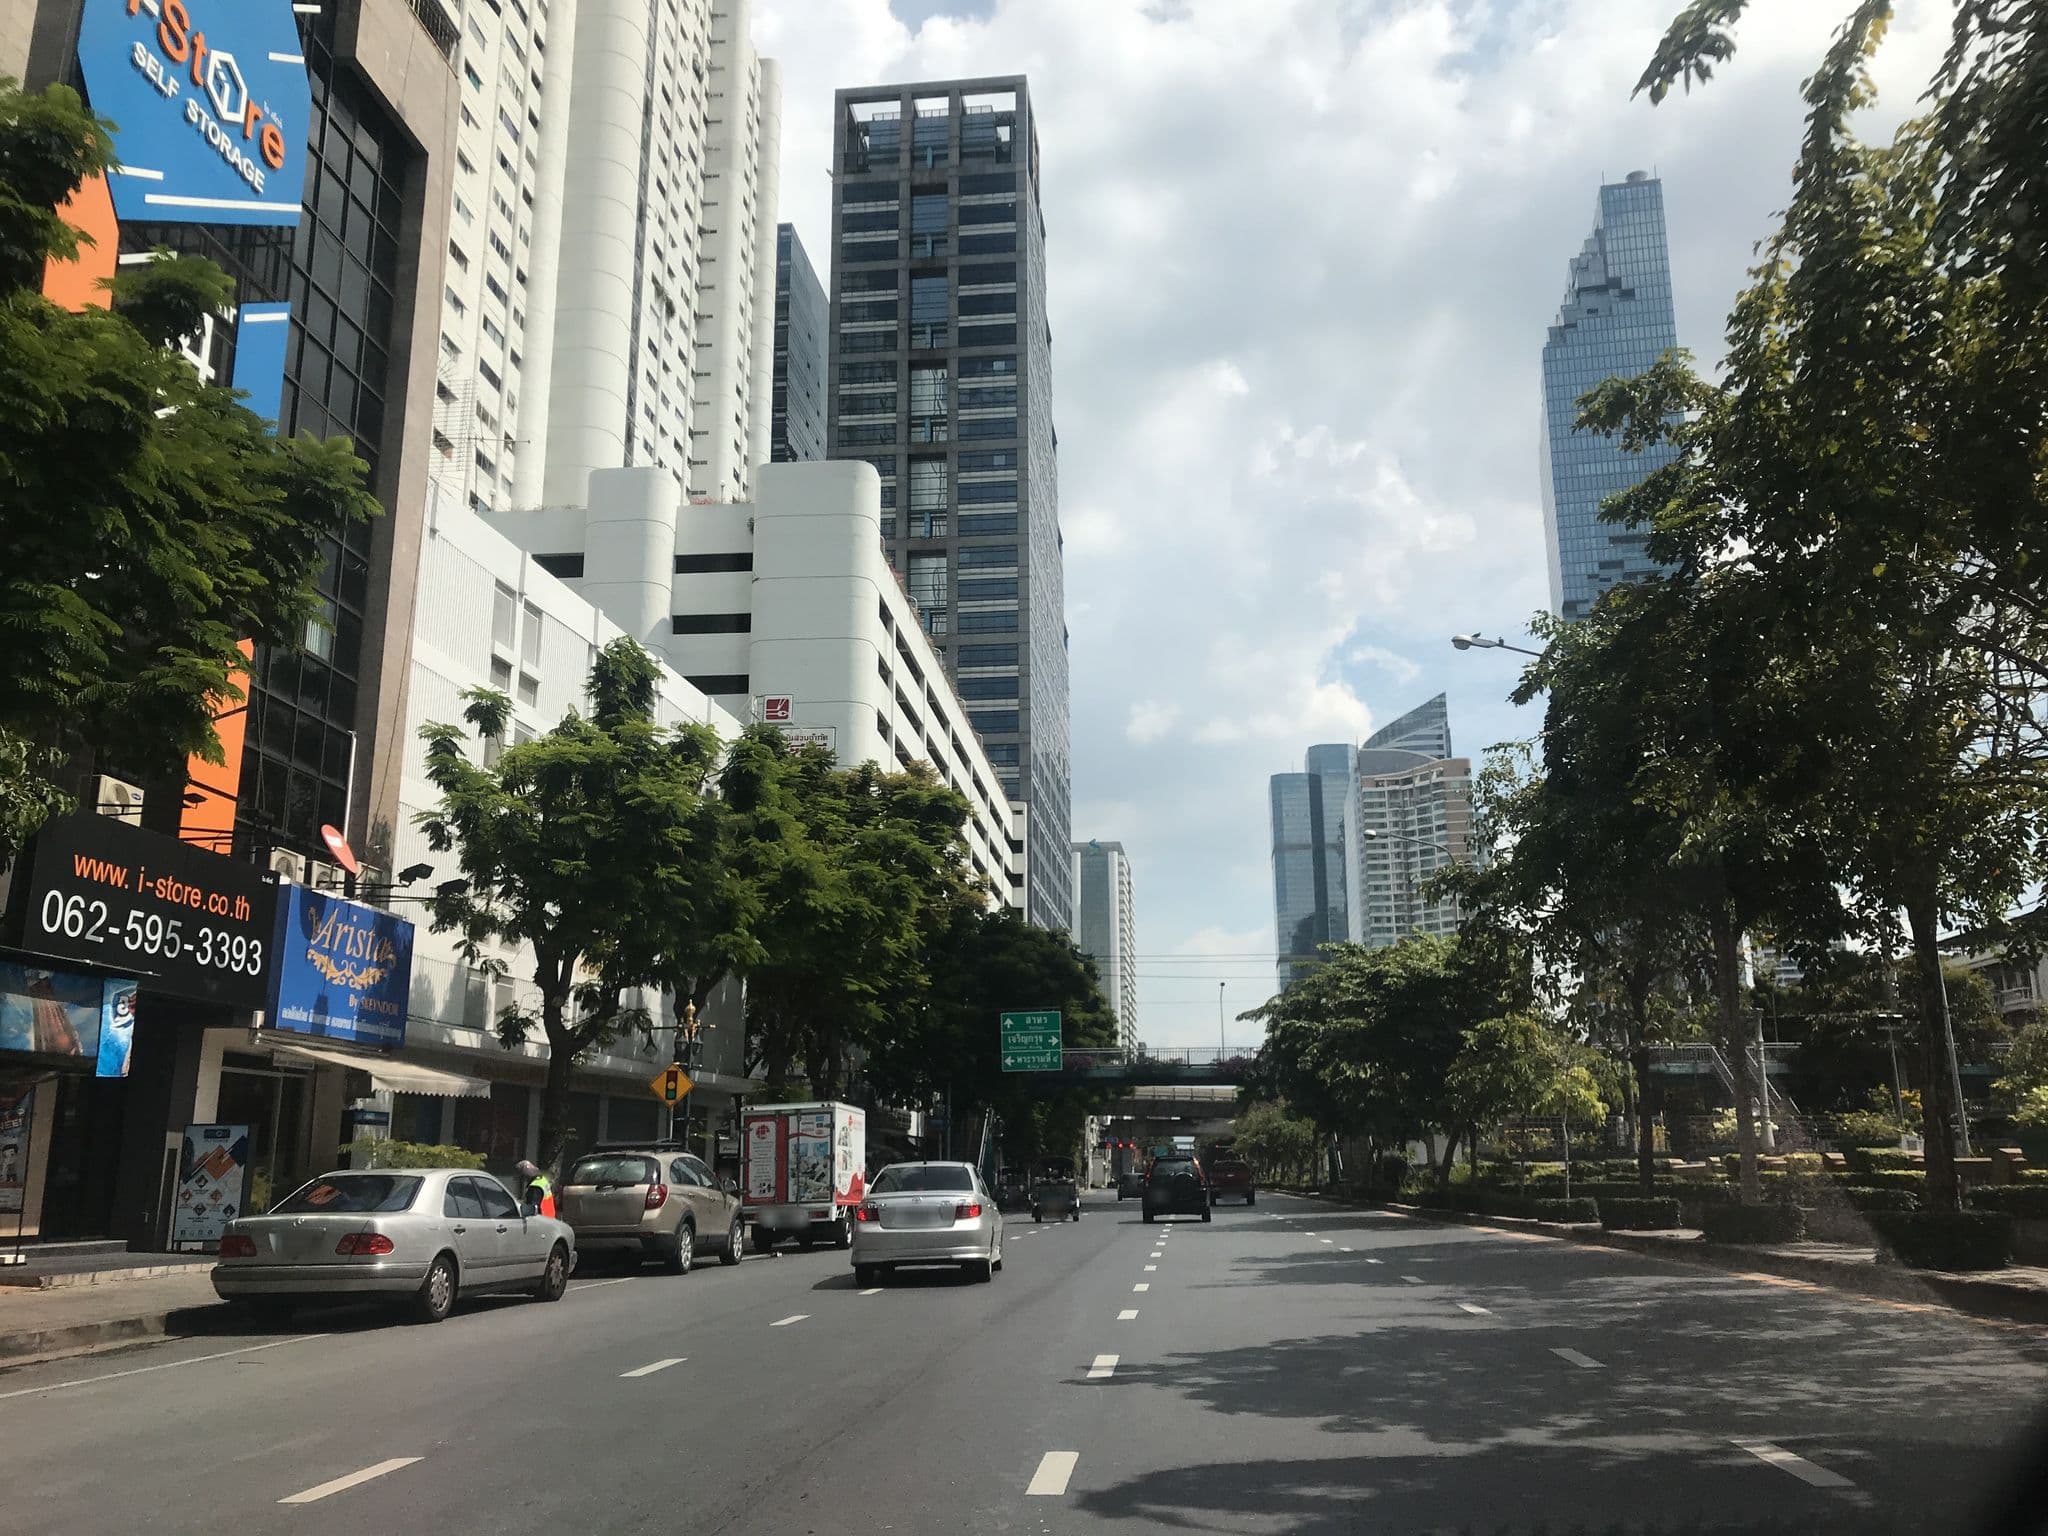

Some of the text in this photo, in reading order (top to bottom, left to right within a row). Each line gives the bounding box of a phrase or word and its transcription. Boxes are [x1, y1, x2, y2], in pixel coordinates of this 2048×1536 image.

[133, 41, 265, 194] SELF STORAGE
[74, 854, 250, 922] www. i-store.co.th
[41, 889, 262, 976] 062-595-3393
[308, 907, 397, 967] Arista
[349, 993, 359, 1011] By
